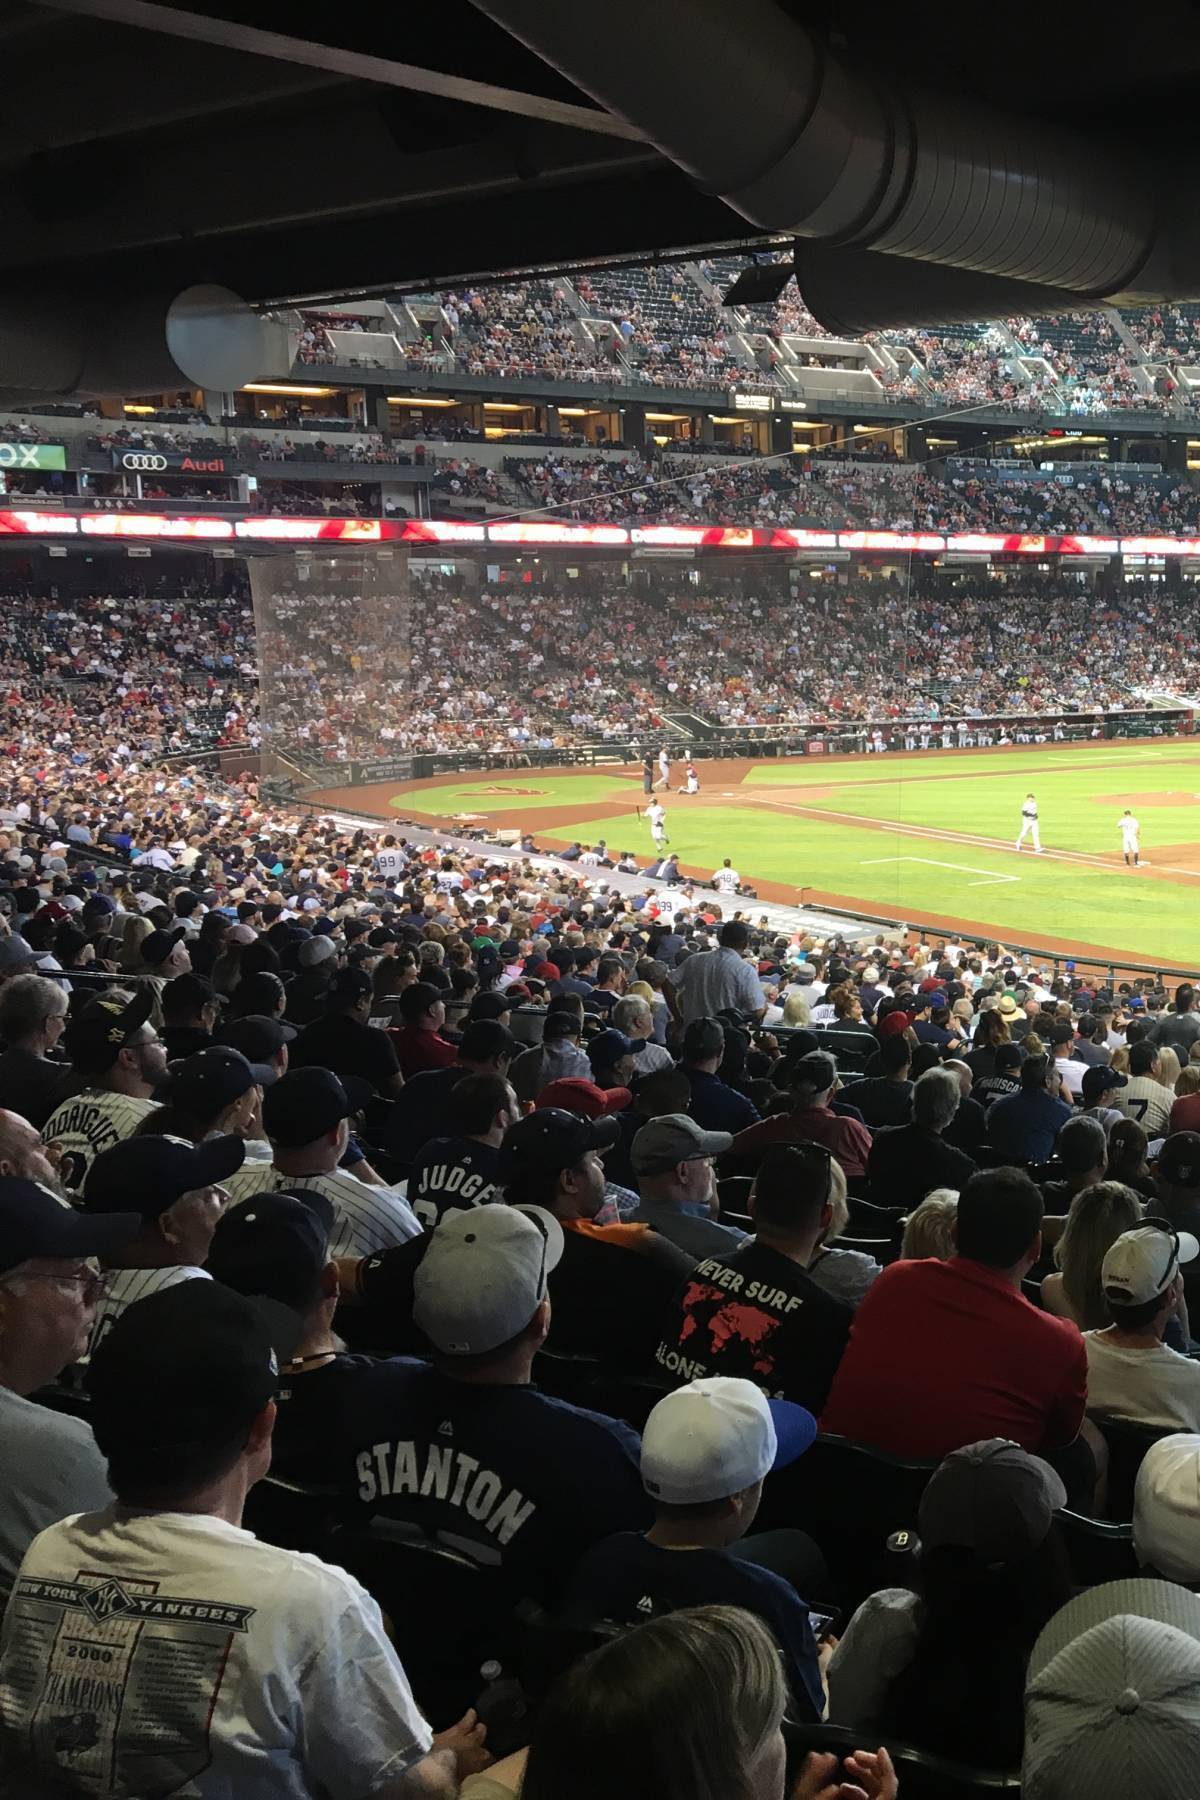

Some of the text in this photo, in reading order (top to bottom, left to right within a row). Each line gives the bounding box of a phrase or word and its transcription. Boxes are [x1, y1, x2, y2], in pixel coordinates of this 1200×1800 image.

[181, 457, 225, 472] Audi
[380, 855, 396, 868] 99
[40, 1104, 120, 1153] ODRIGUE
[1128, 1099, 1149, 1122] 7
[418, 1164, 497, 1207] JUDGE
[693, 1258, 804, 1314] NEVER SURF
[355, 1440, 537, 1546] STANTON
[43, 1585, 79, 1601] YORK
[139, 1599, 241, 1623] YANKEES
[66, 1644, 113, 1664] 2000
[46, 1671, 125, 1714] CHAMPIONS
